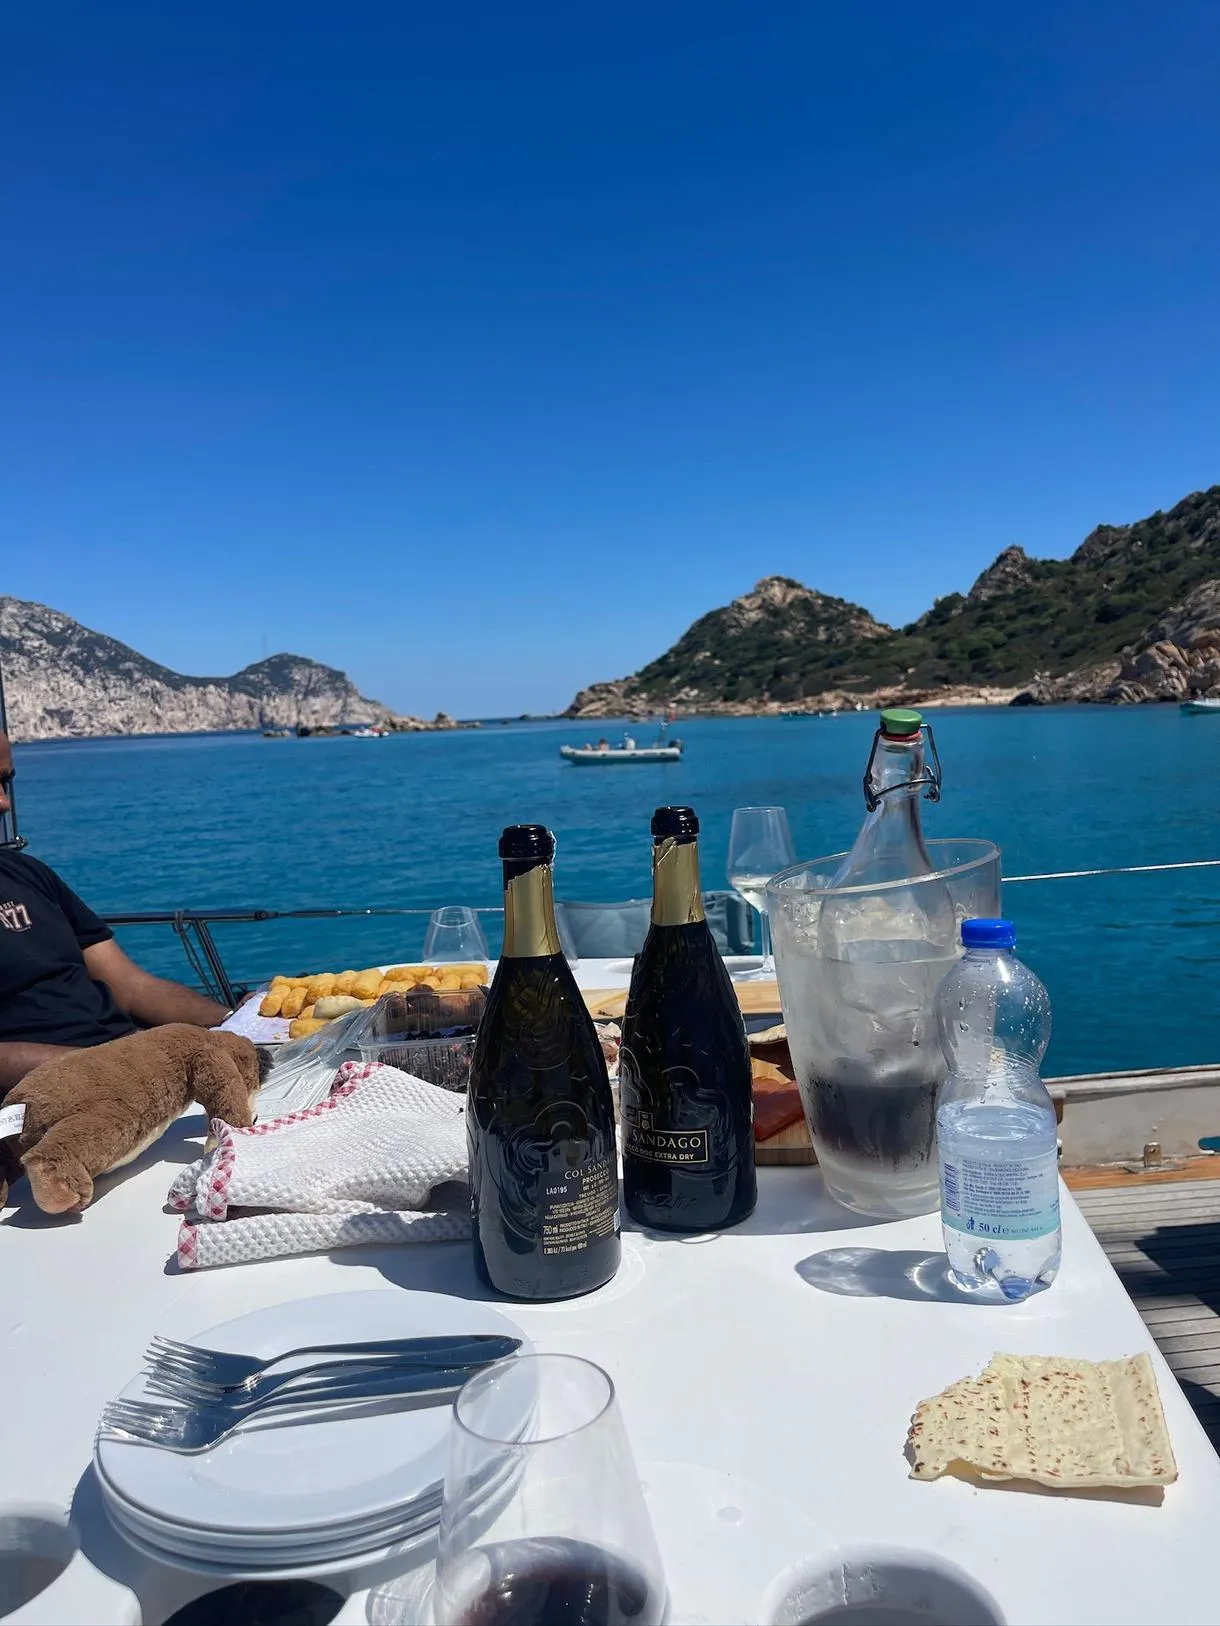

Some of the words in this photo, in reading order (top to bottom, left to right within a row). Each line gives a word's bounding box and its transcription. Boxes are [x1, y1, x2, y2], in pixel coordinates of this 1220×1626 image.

[633, 1128, 701, 1148] SANDAGO
[654, 1151, 677, 1160] EXTRA
[564, 1168, 584, 1180] COL
[582, 1167, 610, 1184] PROSECCO
[979, 1222, 990, 1233] 50
[992, 1223, 1002, 1234] cl
